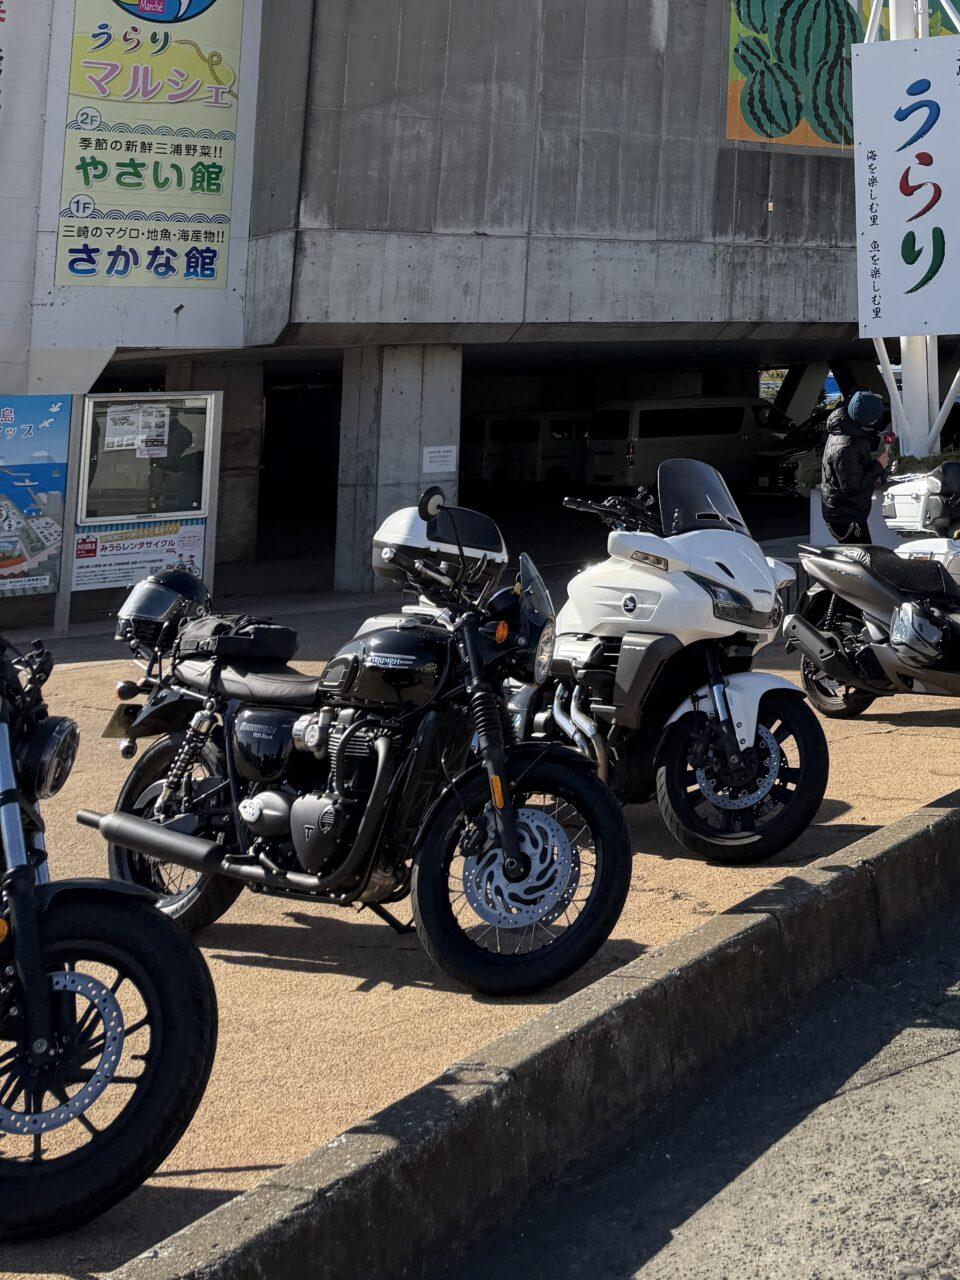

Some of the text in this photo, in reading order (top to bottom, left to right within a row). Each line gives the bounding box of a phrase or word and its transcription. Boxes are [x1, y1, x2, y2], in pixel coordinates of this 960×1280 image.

[88, 23, 170, 56] うらり
[82, 60, 233, 108] マルシェ
[79, 112, 98, 126] 2F
[74, 155, 224, 194] やさい館
[893, 78, 946, 296] うらり
[74, 199, 91, 214] 1F
[67, 243, 218, 280] さかな館
[99, 539, 176, 553] みうらレンタサイクル
[371, 655, 401, 666] TRIUMPH
